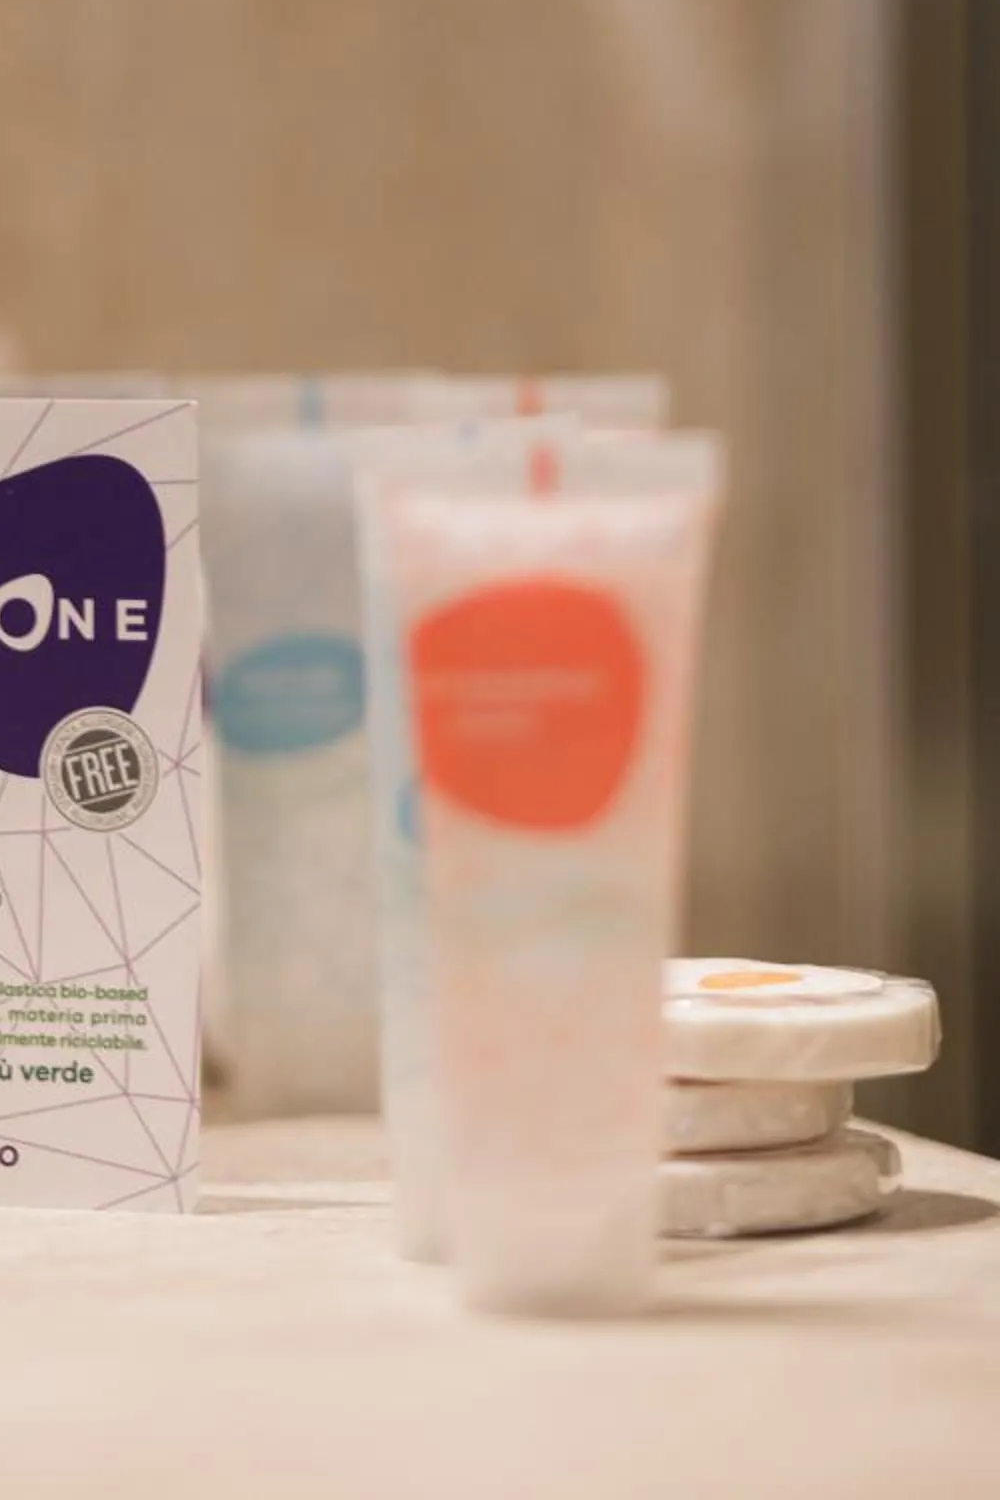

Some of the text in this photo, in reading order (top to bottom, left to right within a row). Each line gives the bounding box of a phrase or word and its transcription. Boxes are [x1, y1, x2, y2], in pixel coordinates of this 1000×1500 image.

[65, 742, 139, 800] FREE
[61, 984, 148, 1001] bio-based
[8, 1007, 83, 1023] materia
[90, 1010, 146, 1027] prima
[20, 1061, 93, 1084] verde
